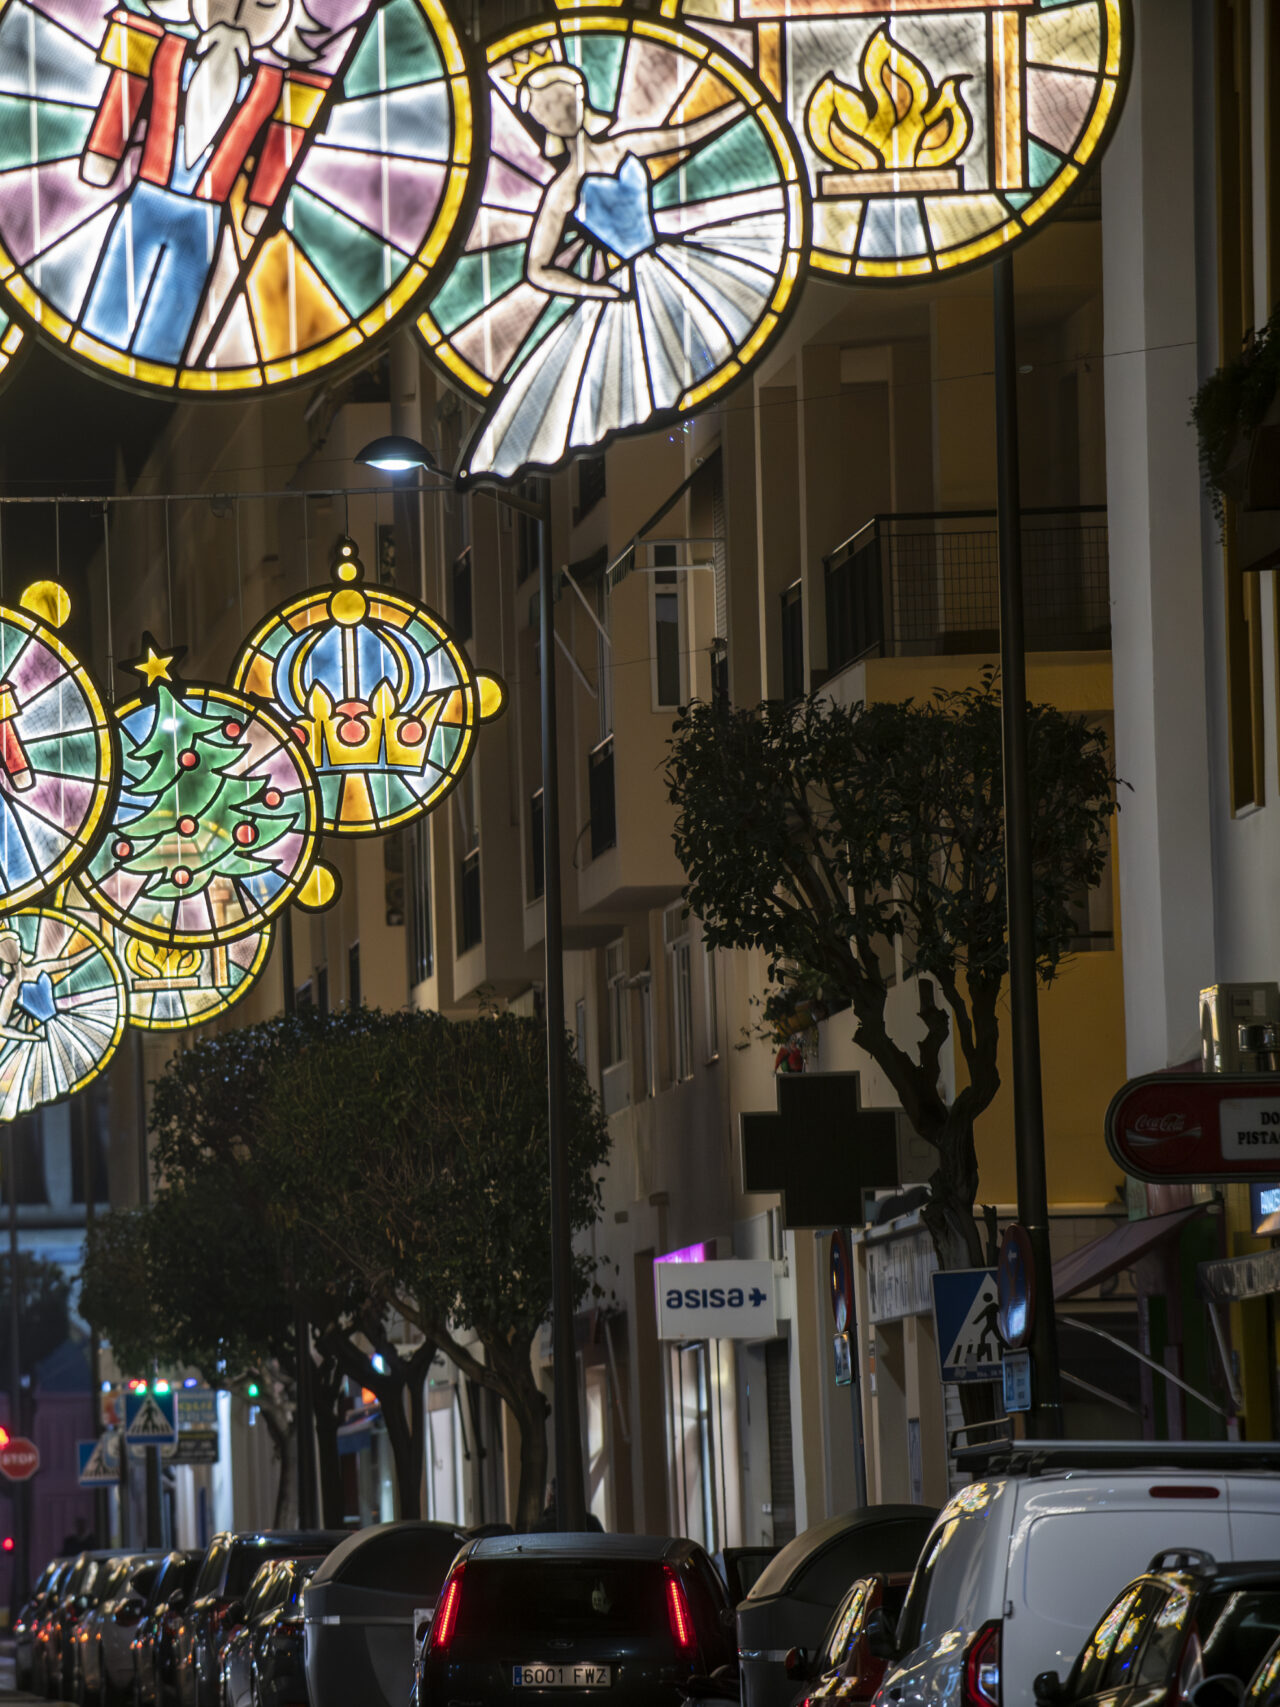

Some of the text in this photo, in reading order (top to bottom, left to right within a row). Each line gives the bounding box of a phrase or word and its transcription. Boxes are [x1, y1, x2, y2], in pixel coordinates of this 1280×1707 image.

[1237, 1131, 1280, 1146] PISTA
[666, 1287, 744, 1309] asisa
[3, 1453, 36, 1465] STOP
[524, 1668, 606, 1684] 6001 FWZ
